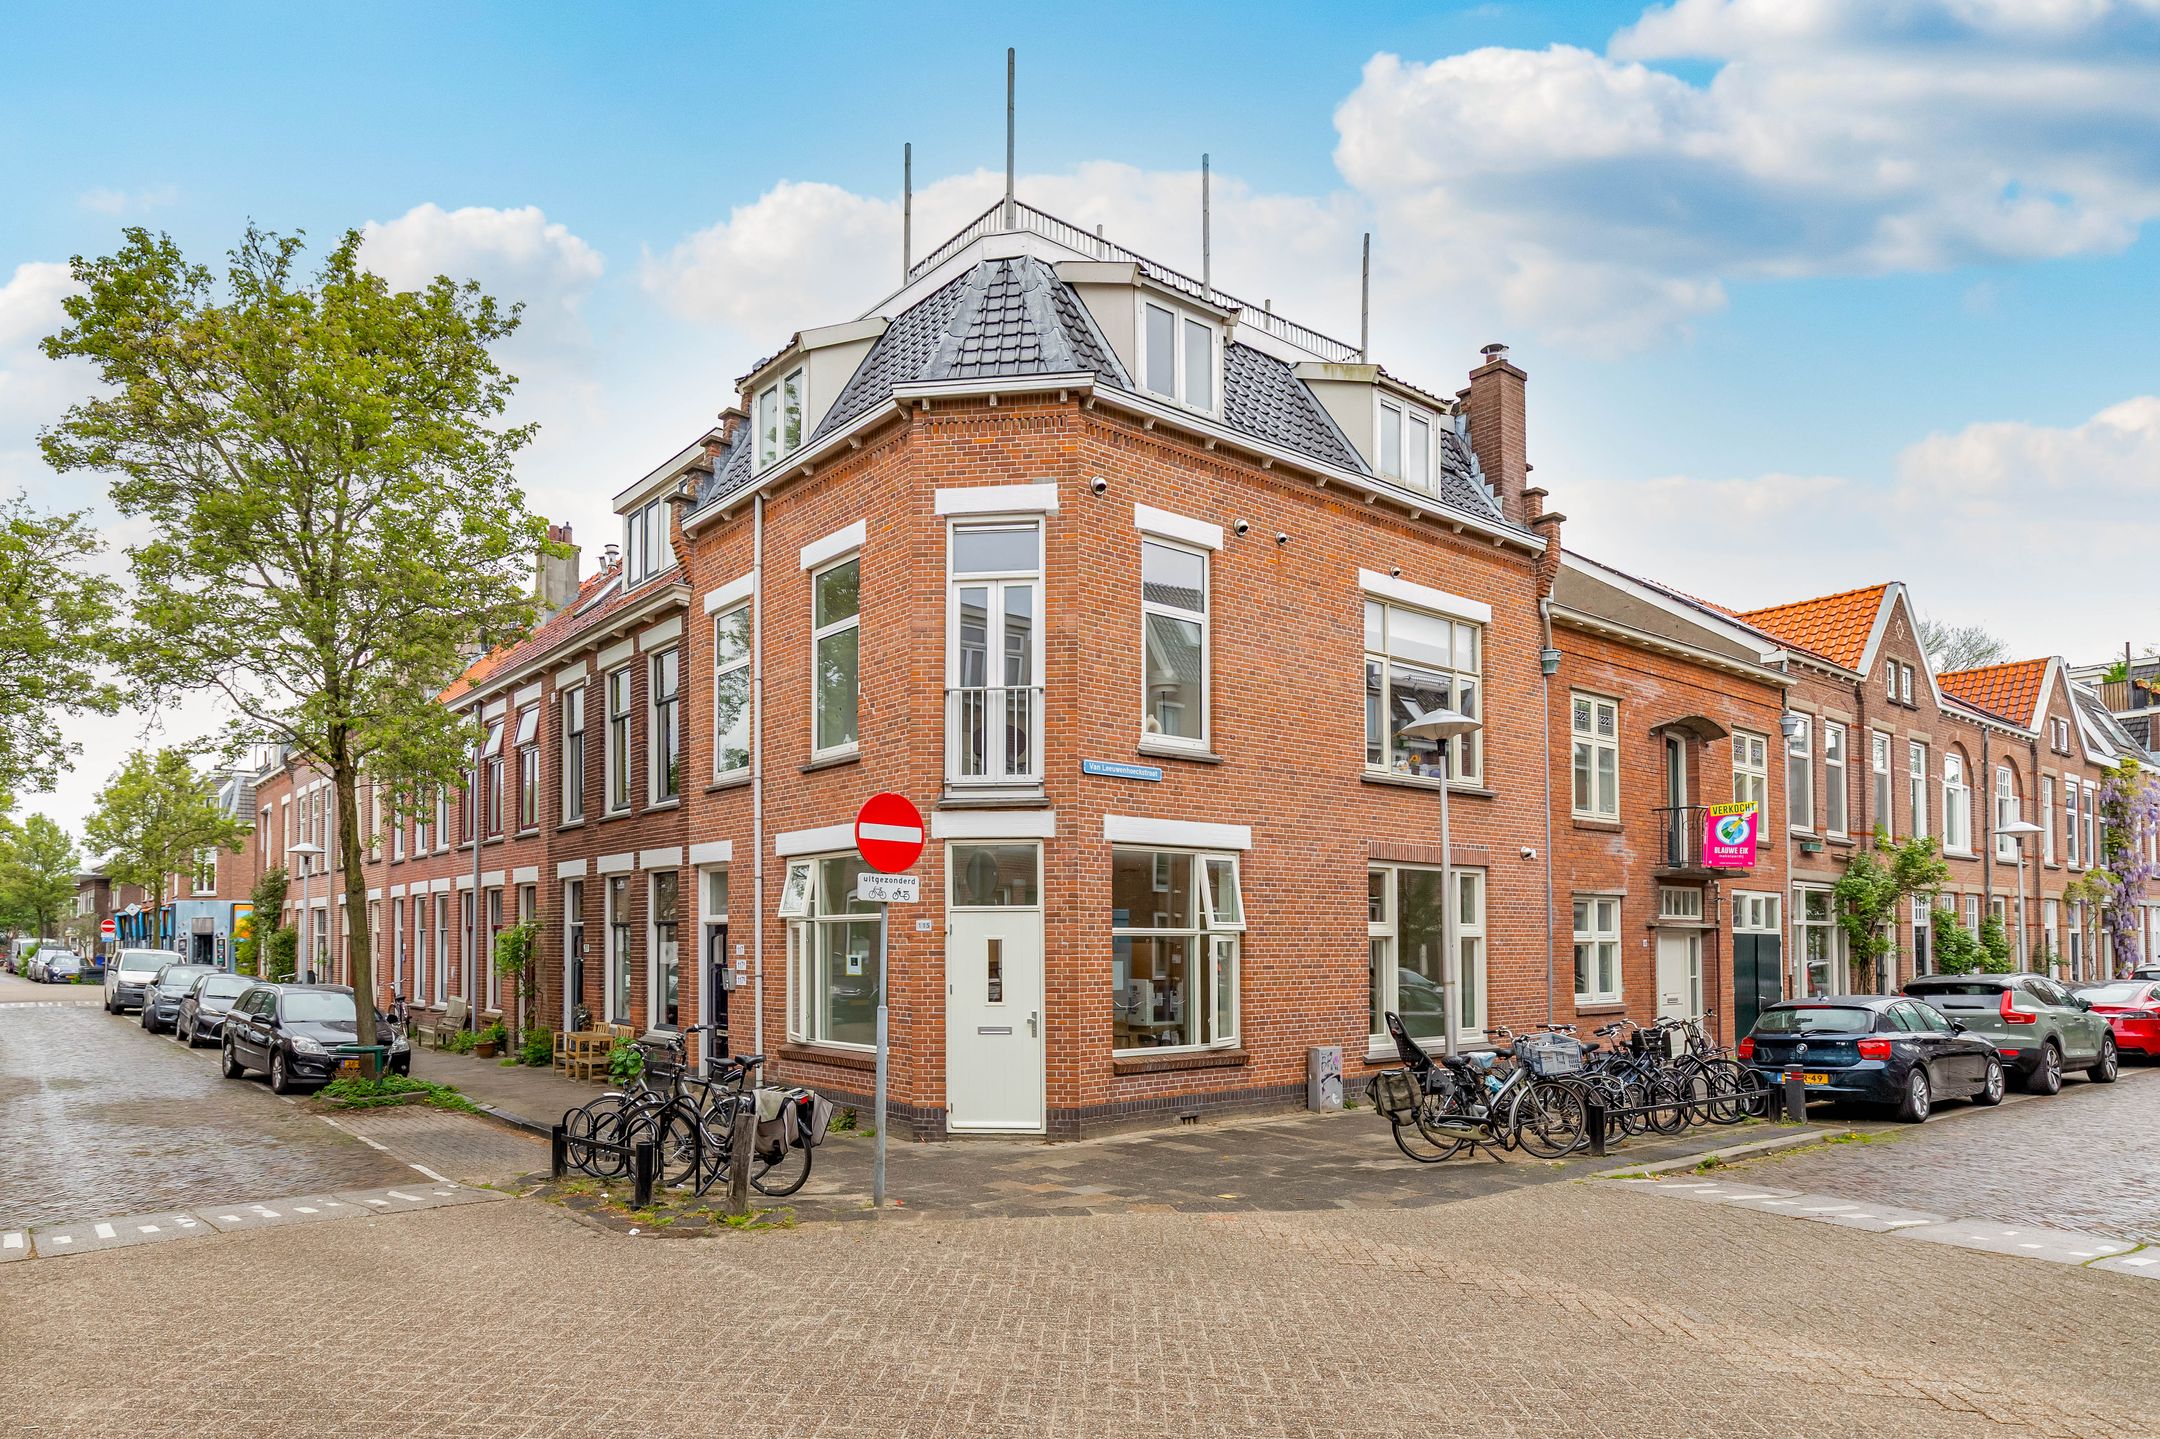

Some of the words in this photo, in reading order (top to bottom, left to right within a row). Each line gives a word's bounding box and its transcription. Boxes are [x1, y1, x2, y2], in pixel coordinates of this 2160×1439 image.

[1089, 762, 1101, 771] Van
[1712, 802, 1755, 815] VERKOCHT
[1714, 846, 1738, 854] BLAUWE
[863, 876, 916, 885] uitgezonderd
[1803, 1074, 1823, 1082] R-49
